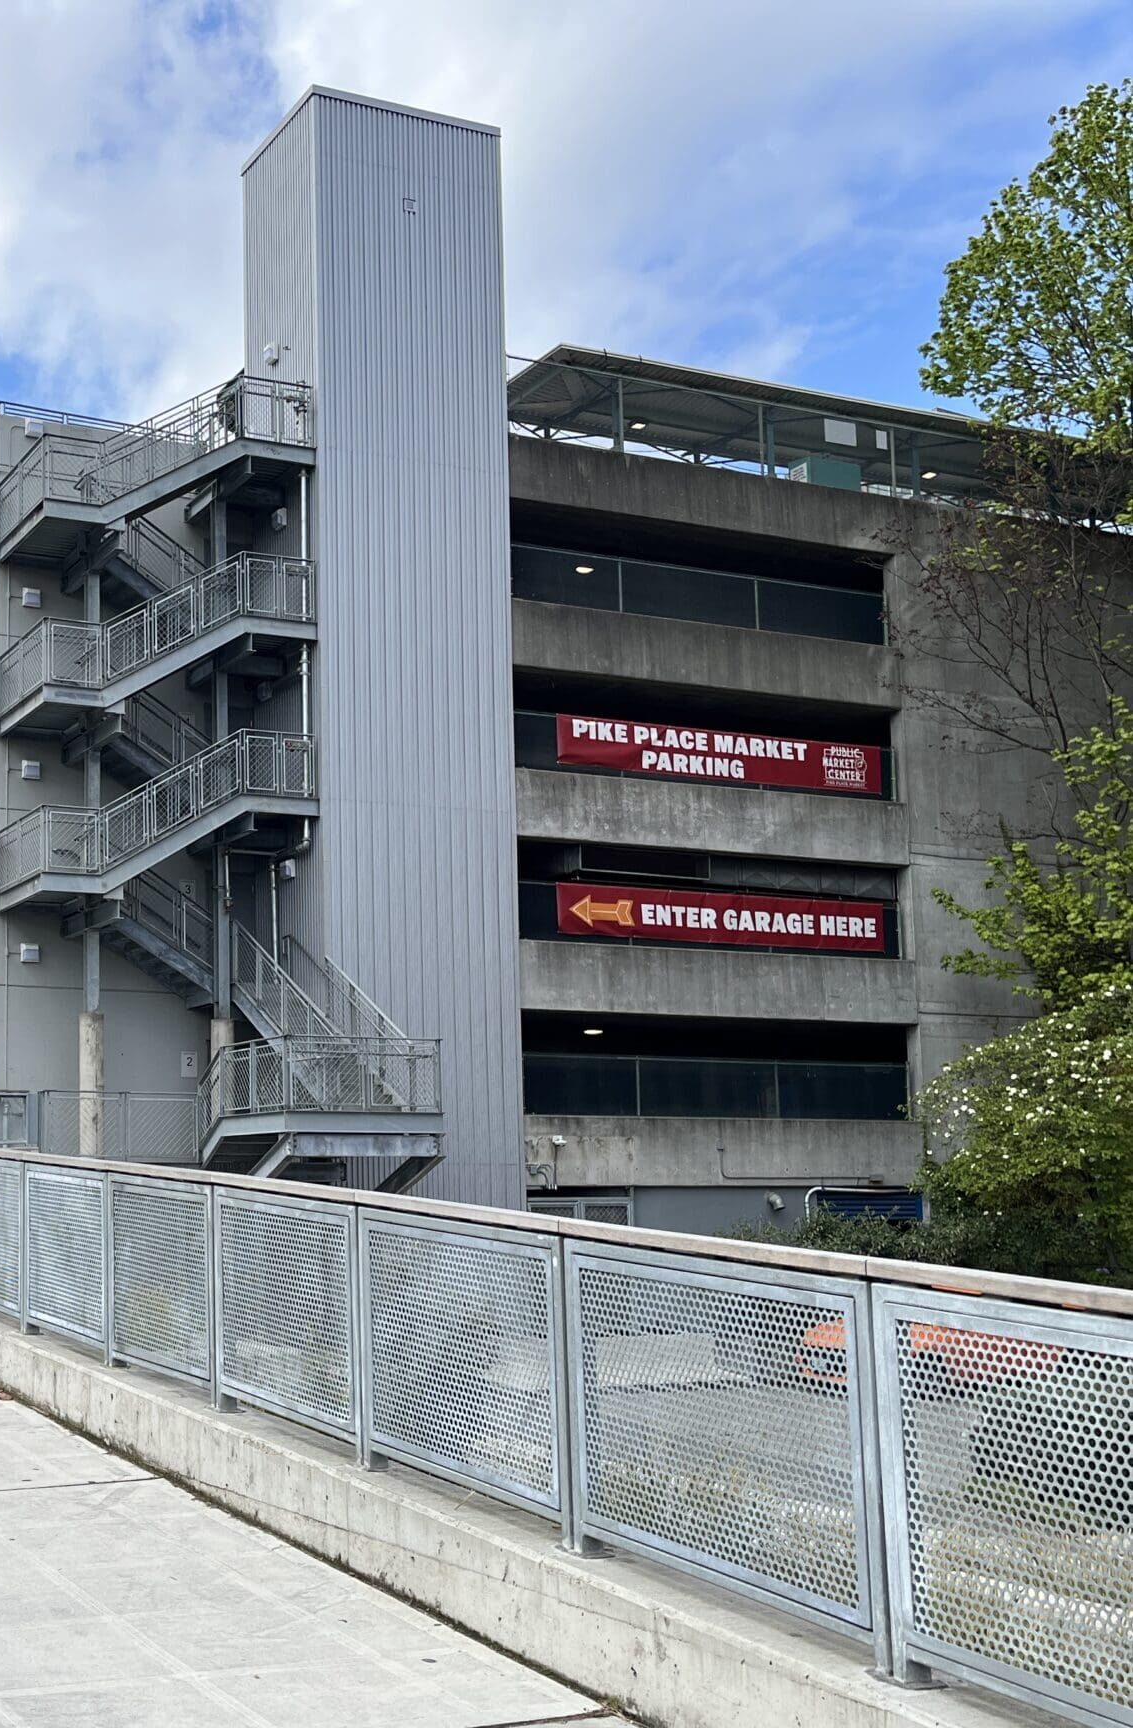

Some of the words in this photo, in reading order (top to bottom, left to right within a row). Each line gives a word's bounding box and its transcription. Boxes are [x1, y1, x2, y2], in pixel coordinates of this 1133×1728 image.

[571, 718, 628, 744] PIKE
[633, 725, 709, 752] PLACE
[713, 734, 808, 761] MARKET
[830, 746, 860, 758] PUBLIC
[641, 749, 745, 779] PARKING
[822, 756, 855, 769] MARKET
[827, 769, 861, 781] CENTER
[185, 884, 191, 895] 3
[640, 903, 717, 930] ENTER
[722, 908, 815, 935] GARAGE
[820, 914, 877, 938] HERE
[186, 1056, 193, 1067] 2
